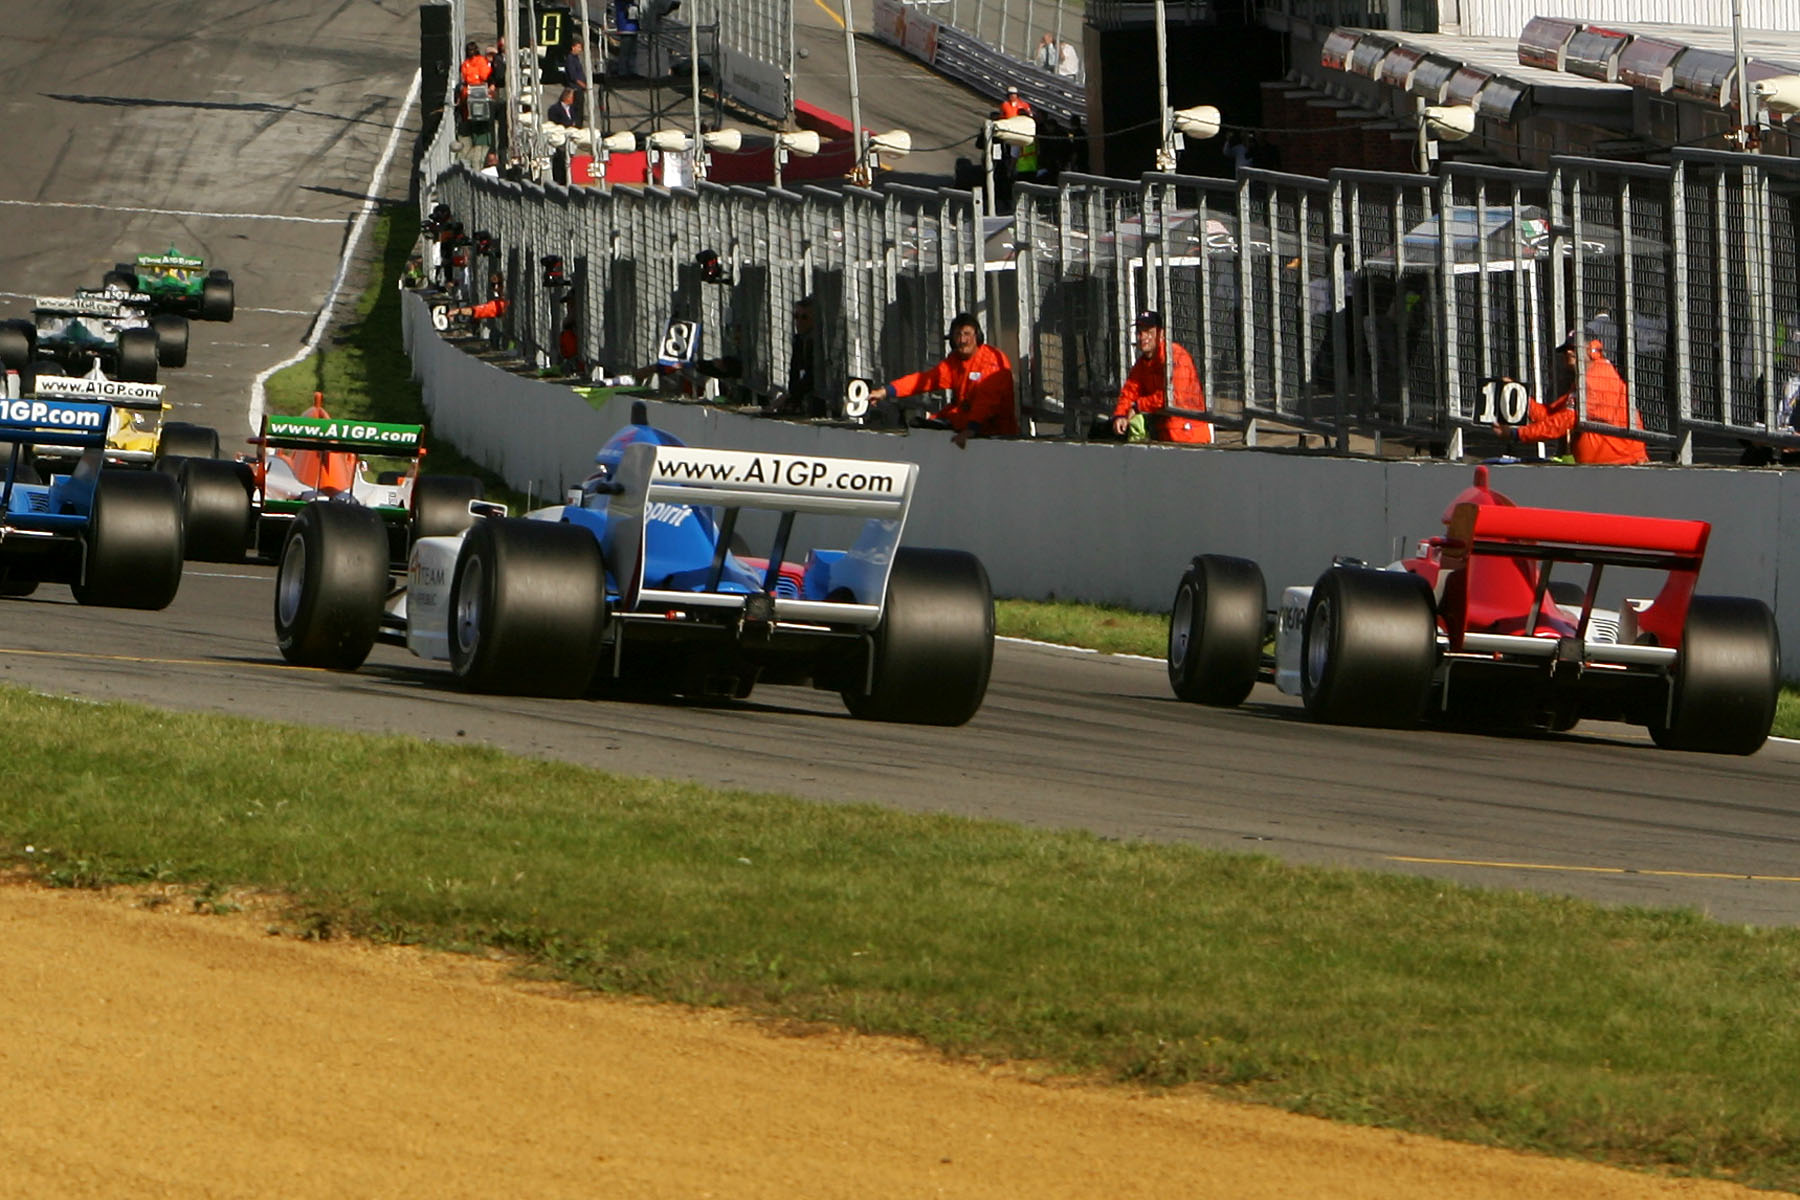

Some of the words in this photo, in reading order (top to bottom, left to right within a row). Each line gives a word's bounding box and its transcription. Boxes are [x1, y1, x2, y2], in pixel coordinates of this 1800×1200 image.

[541, 12, 561, 46] 0
[432, 304, 448, 331] 6
[665, 323, 688, 357] 8
[41, 380, 160, 398] www.A1GP.com
[846, 379, 869, 417] 9
[1480, 381, 1528, 424] 10
[270, 422, 418, 443] www.A1GP.com
[657, 457, 893, 493] www.A1GP.com
